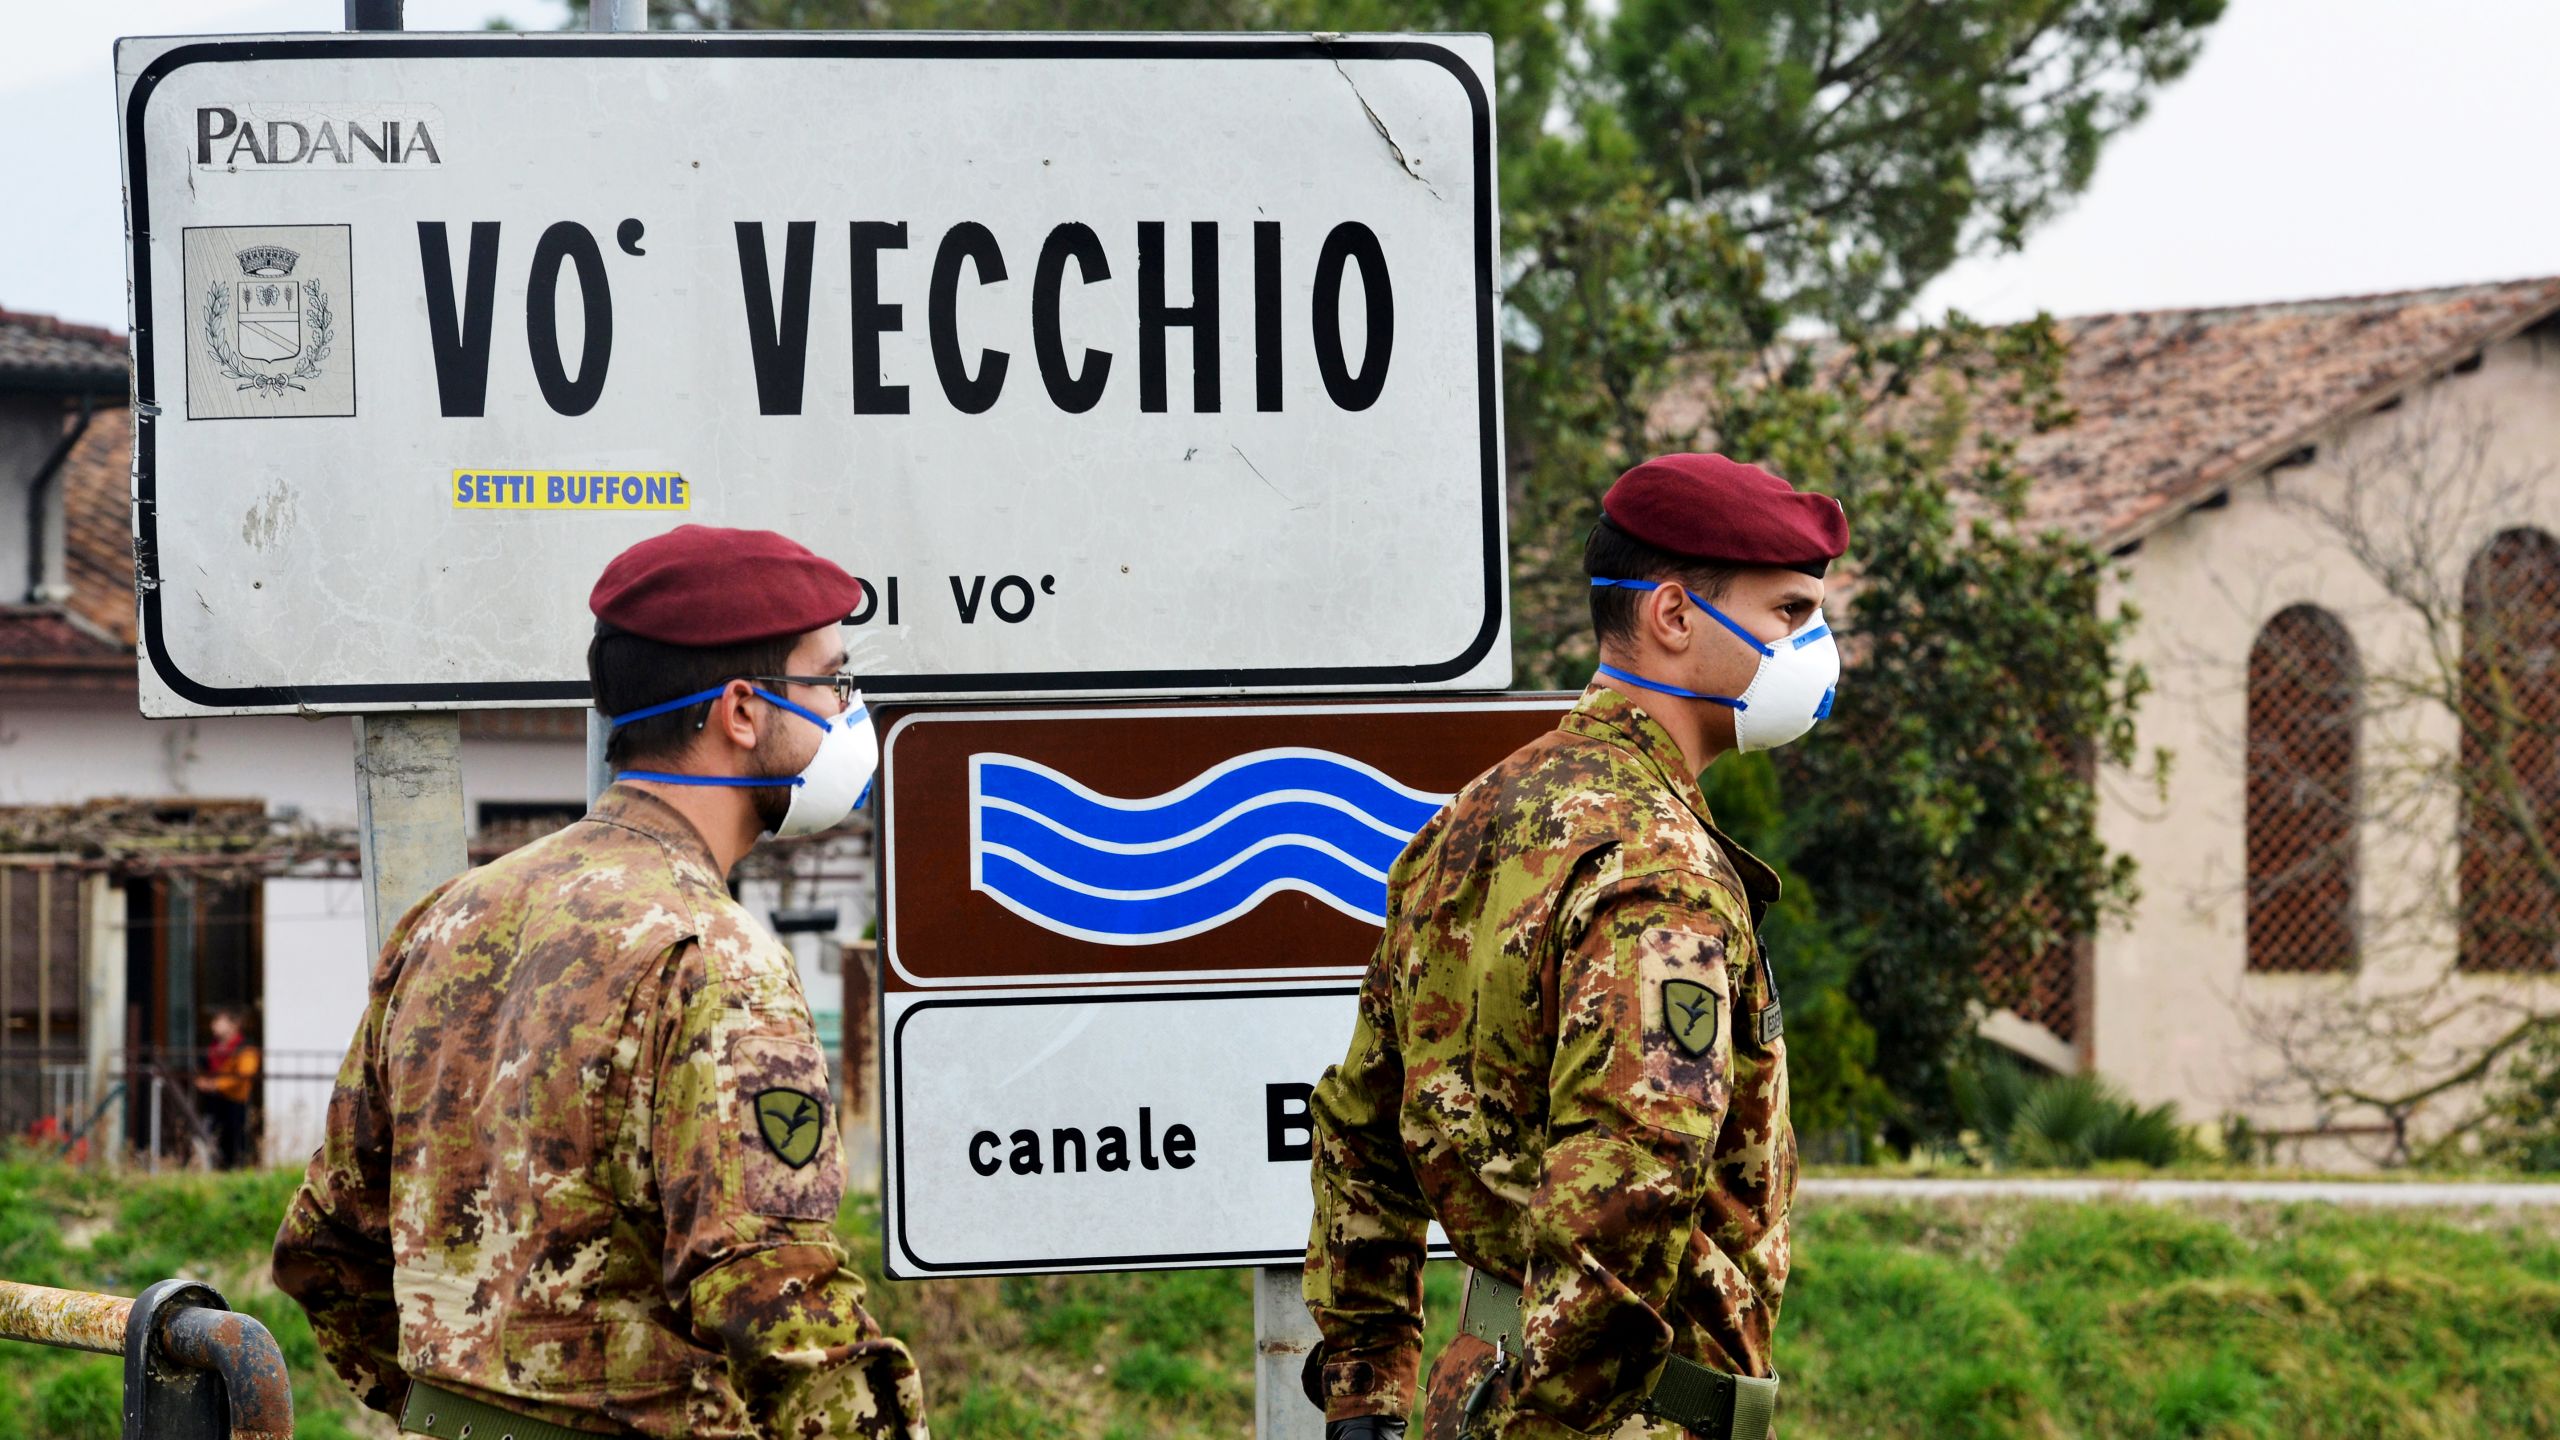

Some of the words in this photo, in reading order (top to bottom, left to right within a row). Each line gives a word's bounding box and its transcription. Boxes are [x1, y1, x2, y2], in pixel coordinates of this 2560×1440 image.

[197, 107, 441, 164] PADANIA
[734, 221, 1394, 415] VECCHIO
[457, 474, 535, 504] SETTI
[547, 475, 685, 505] BUFFONE
[841, 576, 899, 626] DI
[968, 1107, 1197, 1177] canale
